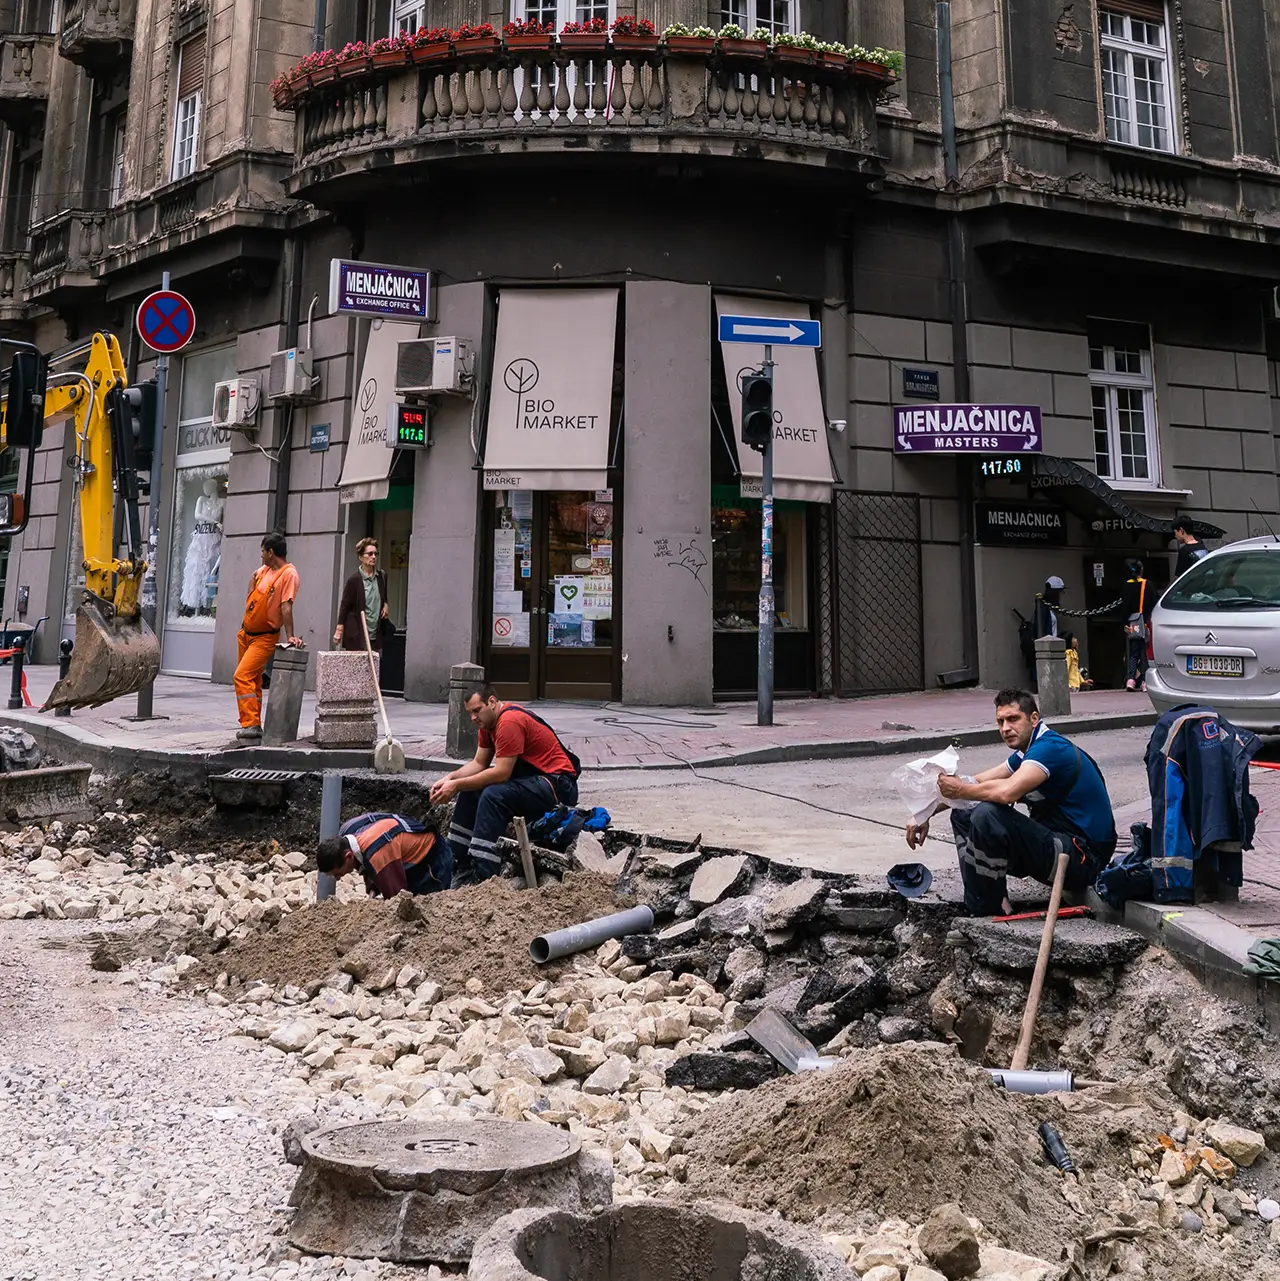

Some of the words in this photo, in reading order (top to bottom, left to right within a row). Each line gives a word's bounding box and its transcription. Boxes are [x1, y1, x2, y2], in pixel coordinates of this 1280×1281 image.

[346, 271, 421, 299] MENJAČNICA
[356, 297, 388, 308] EXCHANGE
[389, 301, 410, 310] OFFICE
[525, 399, 555, 413] BIO
[364, 415, 378, 430] BIO
[523, 415, 599, 429] MARKET
[898, 406, 1036, 433] MENJAČNICA
[184, 428, 209, 450] CLICK
[361, 428, 387, 445] MARKE
[772, 426, 818, 442] ARKET
[934, 437, 999, 448] MASTERS
[981, 459, 1021, 475] 117.60
[485, 477, 522, 485] MARKET
[988, 509, 1061, 528] MENJAČNICA
[1193, 656, 1203, 669] BG
